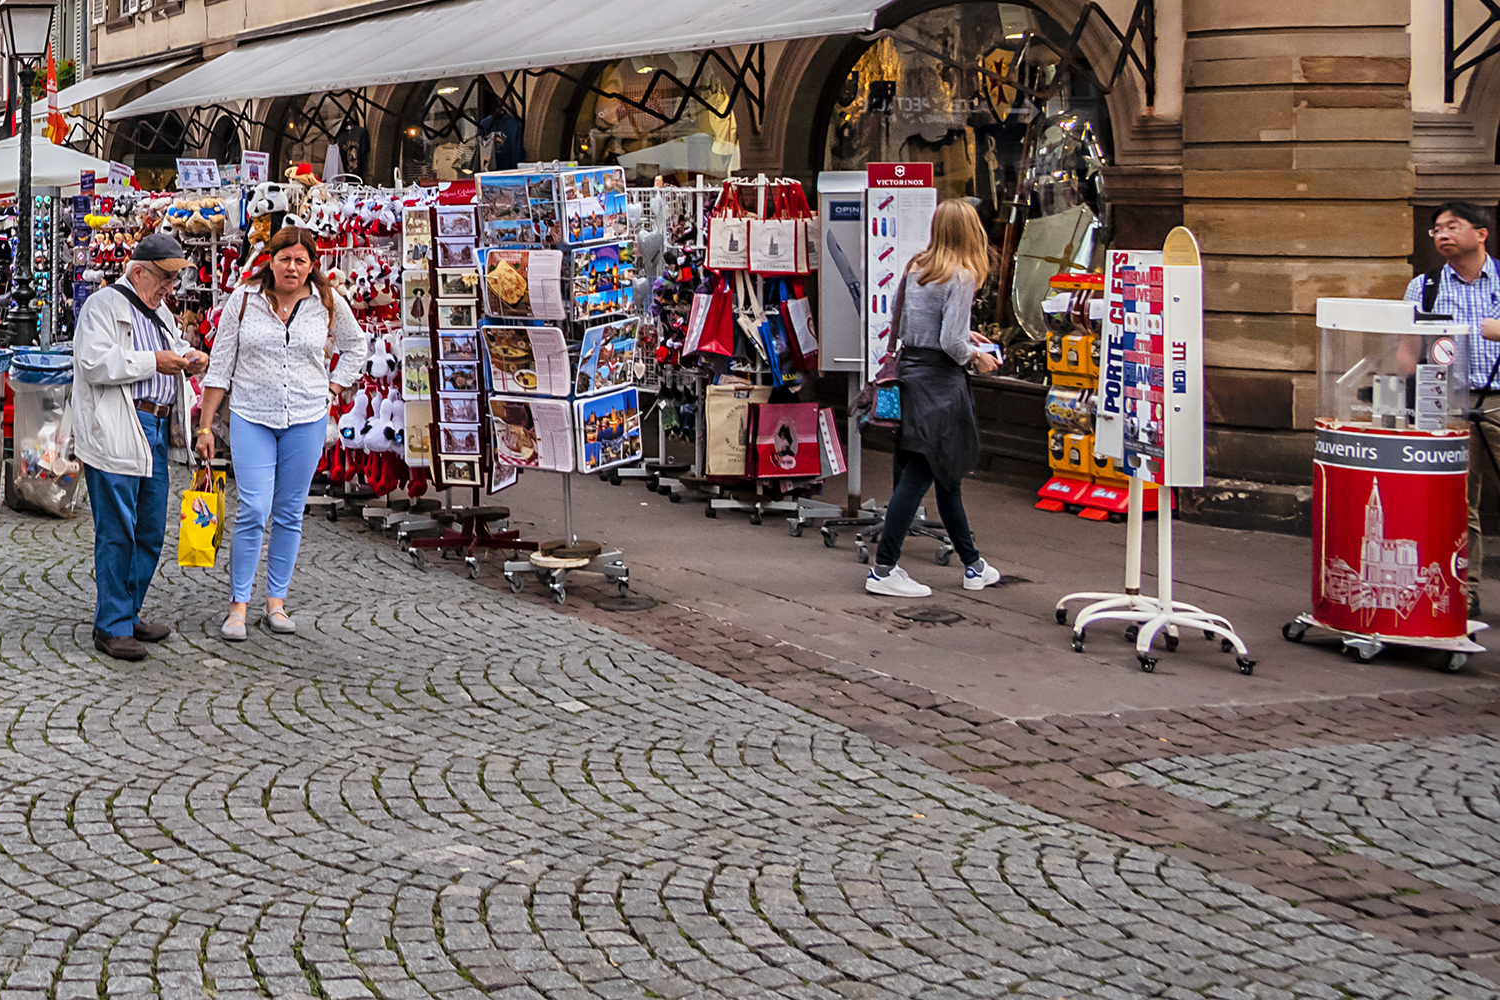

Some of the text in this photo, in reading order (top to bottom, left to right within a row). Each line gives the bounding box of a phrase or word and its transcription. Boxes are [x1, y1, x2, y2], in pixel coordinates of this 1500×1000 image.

[1124, 270, 1163, 286] MEDAILLE
[1124, 362, 1164, 387] FRANCE
[1172, 341, 1187, 394] MEDAILLE
